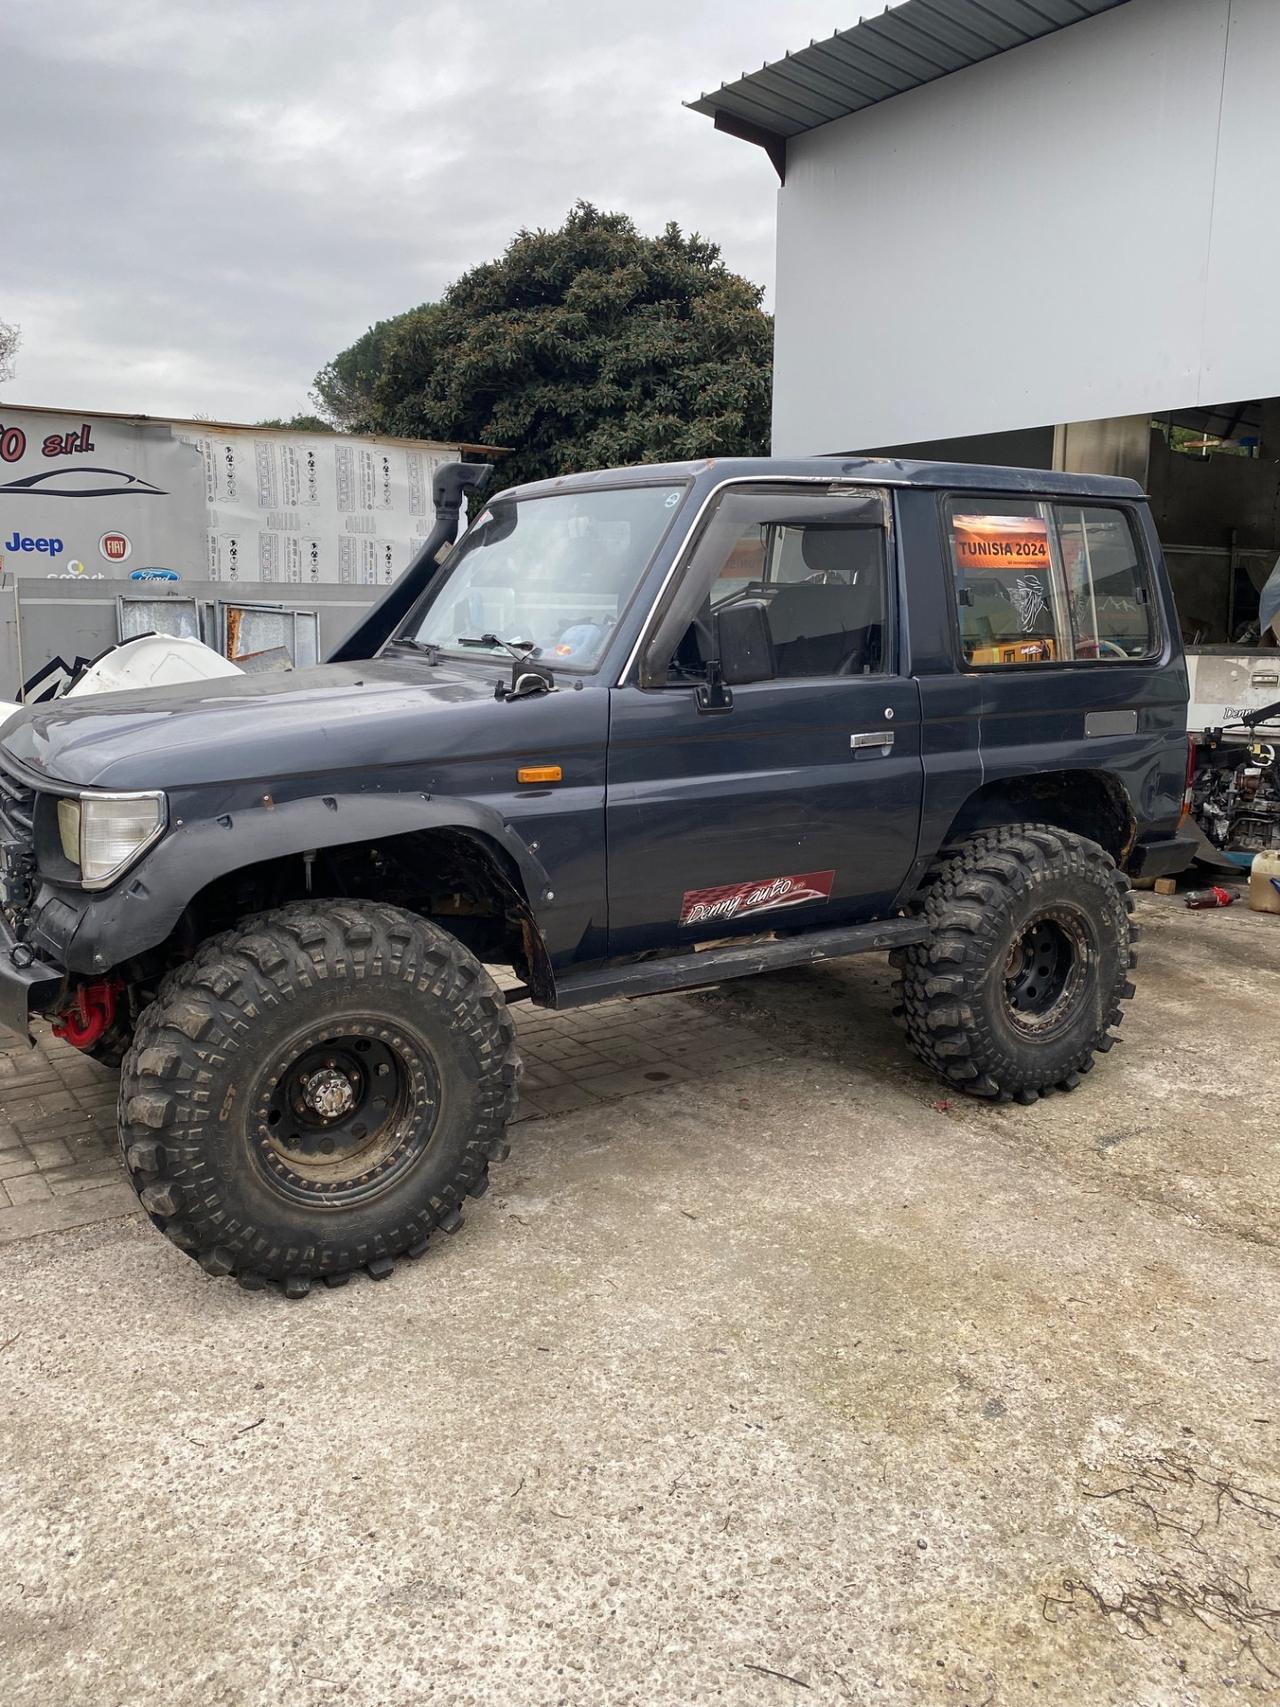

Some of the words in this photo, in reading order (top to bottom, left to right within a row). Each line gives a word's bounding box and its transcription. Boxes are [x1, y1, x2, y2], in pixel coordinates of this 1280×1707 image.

[5, 532, 63, 556] Jeep
[107, 540, 125, 554] FIAT
[959, 542, 1013, 556] TUNISIA
[1016, 543, 1046, 556] 2024
[687, 897, 740, 924] Denny
[747, 878, 792, 905] auto
